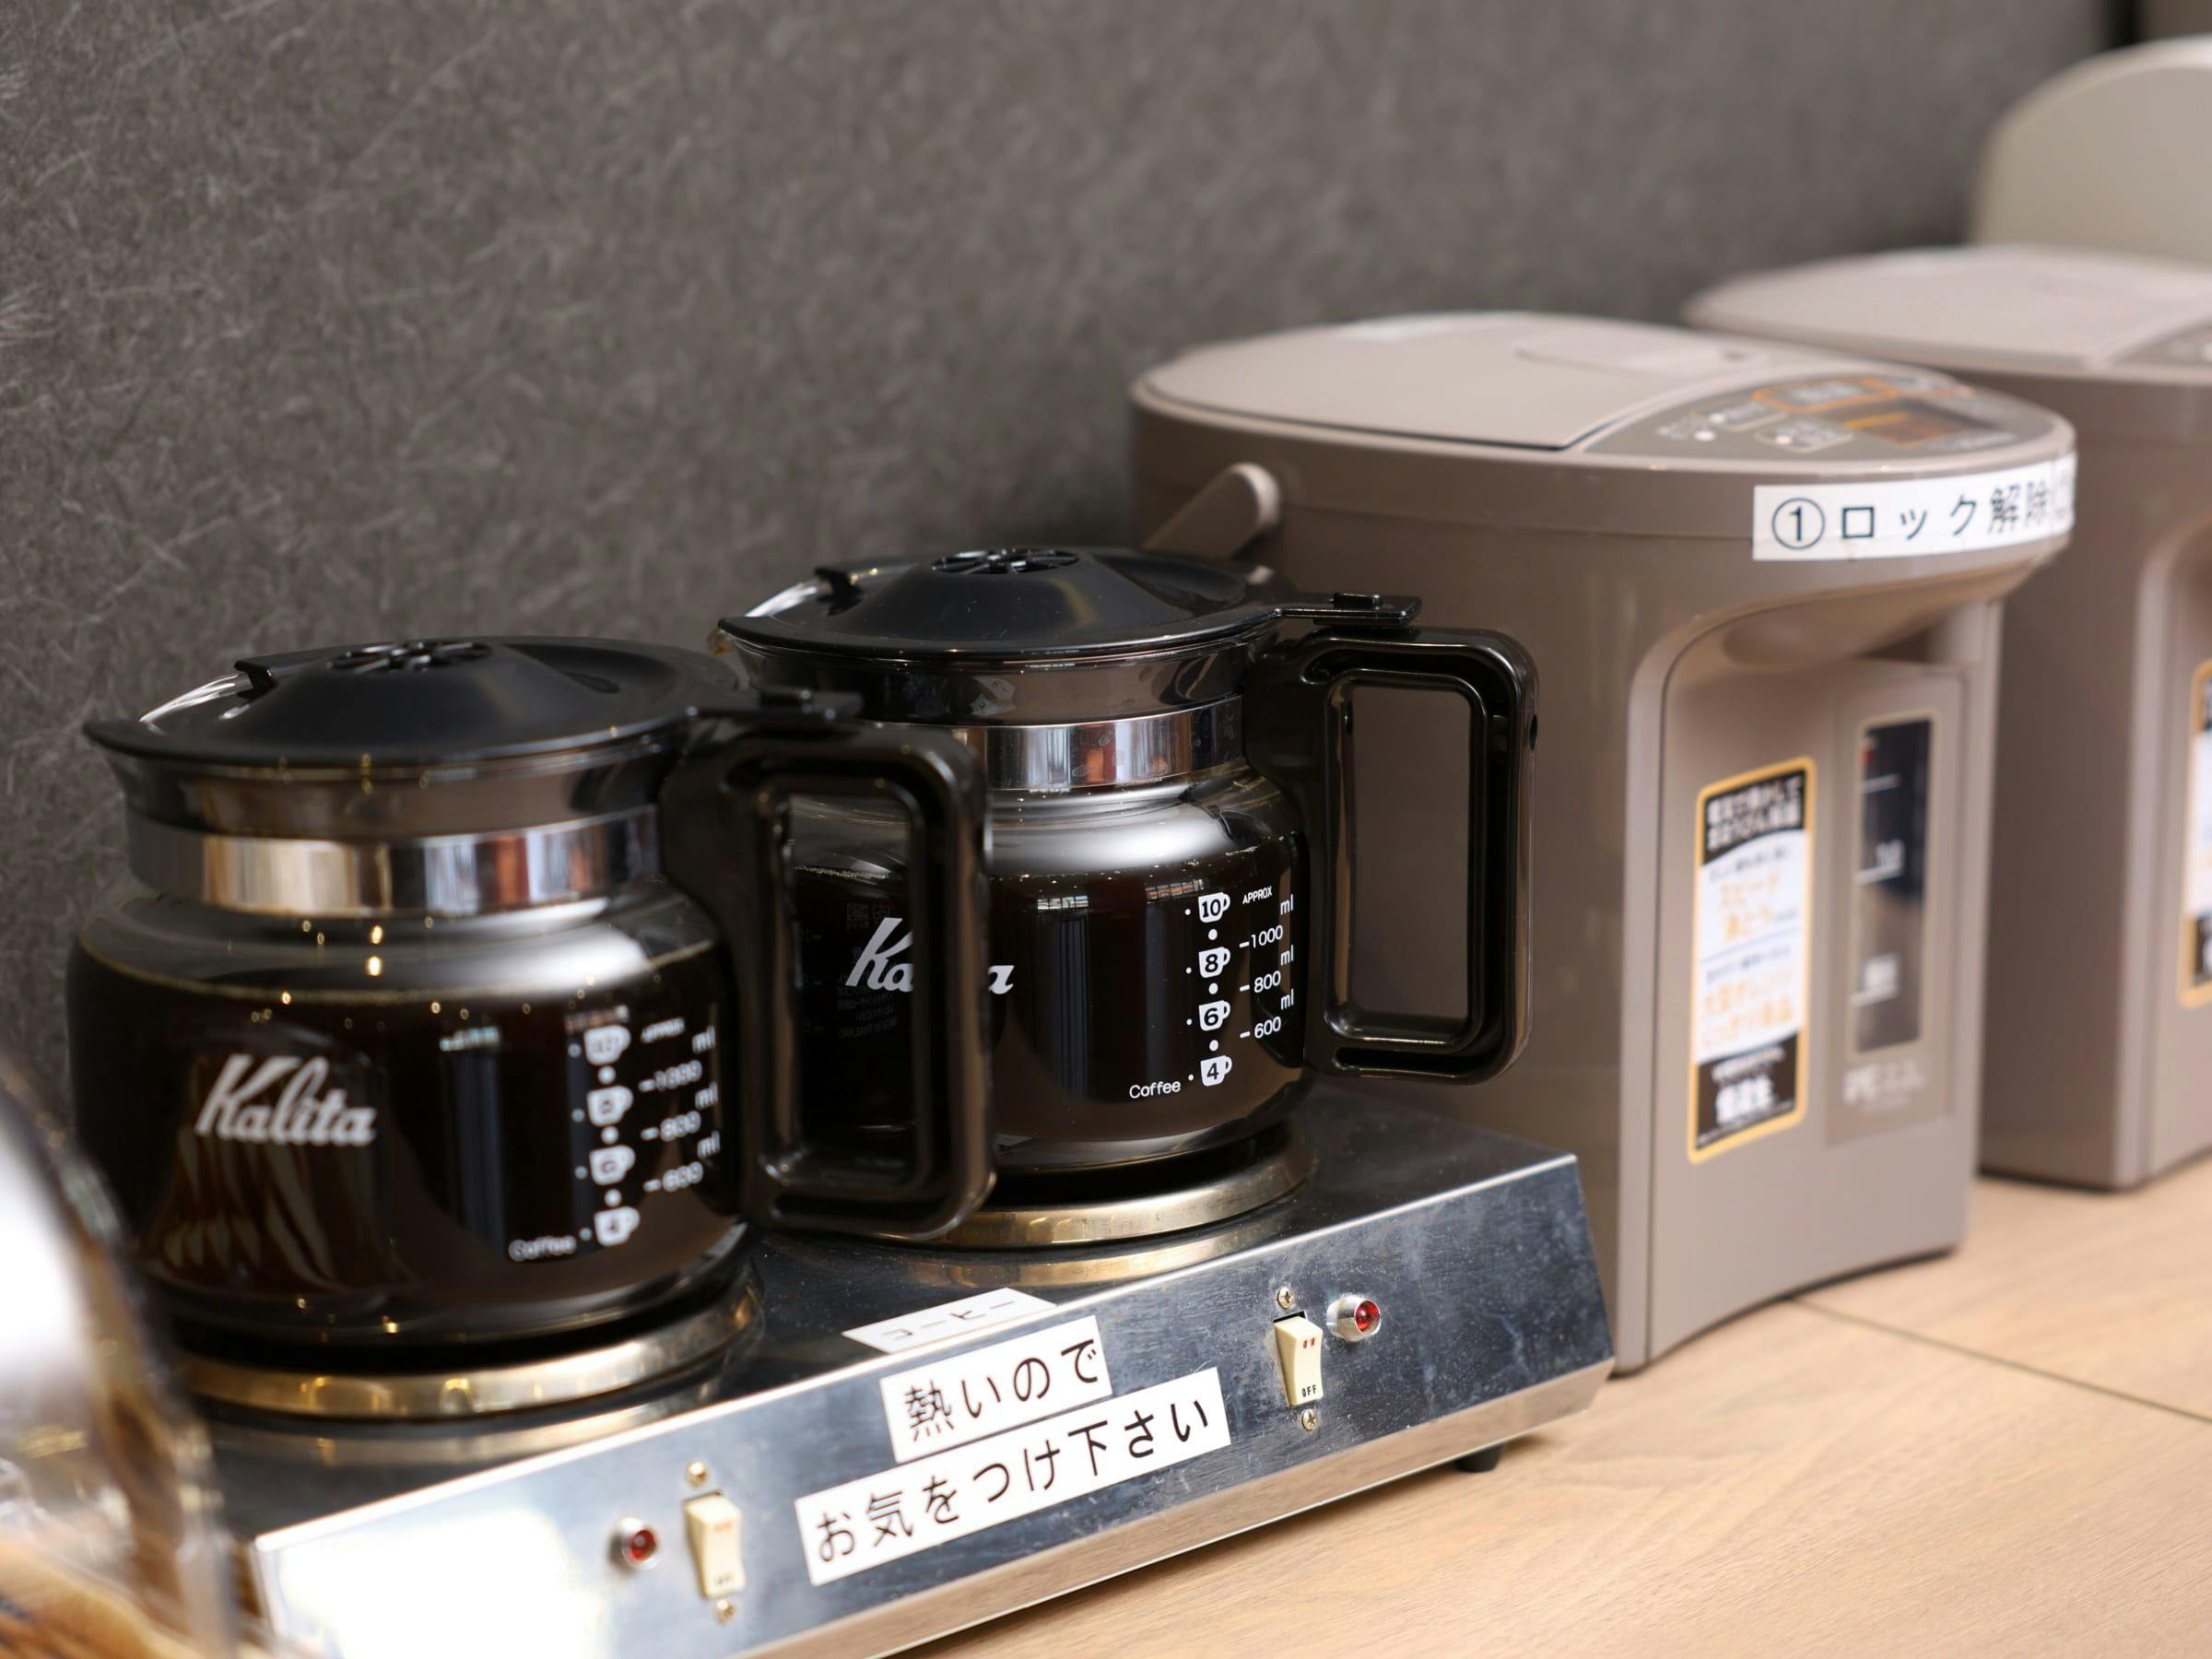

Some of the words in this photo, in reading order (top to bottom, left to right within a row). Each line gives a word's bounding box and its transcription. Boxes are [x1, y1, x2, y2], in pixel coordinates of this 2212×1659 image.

[1241, 885, 1274, 905] APPROX
[1280, 893, 1294, 916] ml
[1201, 899, 1221, 918] 10
[1250, 924, 1284, 949] 1000
[845, 917, 1015, 995] Kaa
[1205, 953, 1218, 973] 8
[1280, 945, 1295, 967] ml
[1253, 970, 1282, 994] 800
[1280, 987, 1295, 1011] ml
[1204, 1007, 1219, 1027] 6
[1253, 1016, 1282, 1039] 600
[1206, 1062, 1219, 1080] 4
[194, 1053, 377, 1147] Kalita
[1129, 1081, 1181, 1099] Coffee
[883, 1300, 1015, 1340] コーヒー
[903, 1338, 1100, 1443] 熱いので
[1300, 1384, 1317, 1398] OFF
[816, 1399, 1209, 1564] お気をつけ下さい
